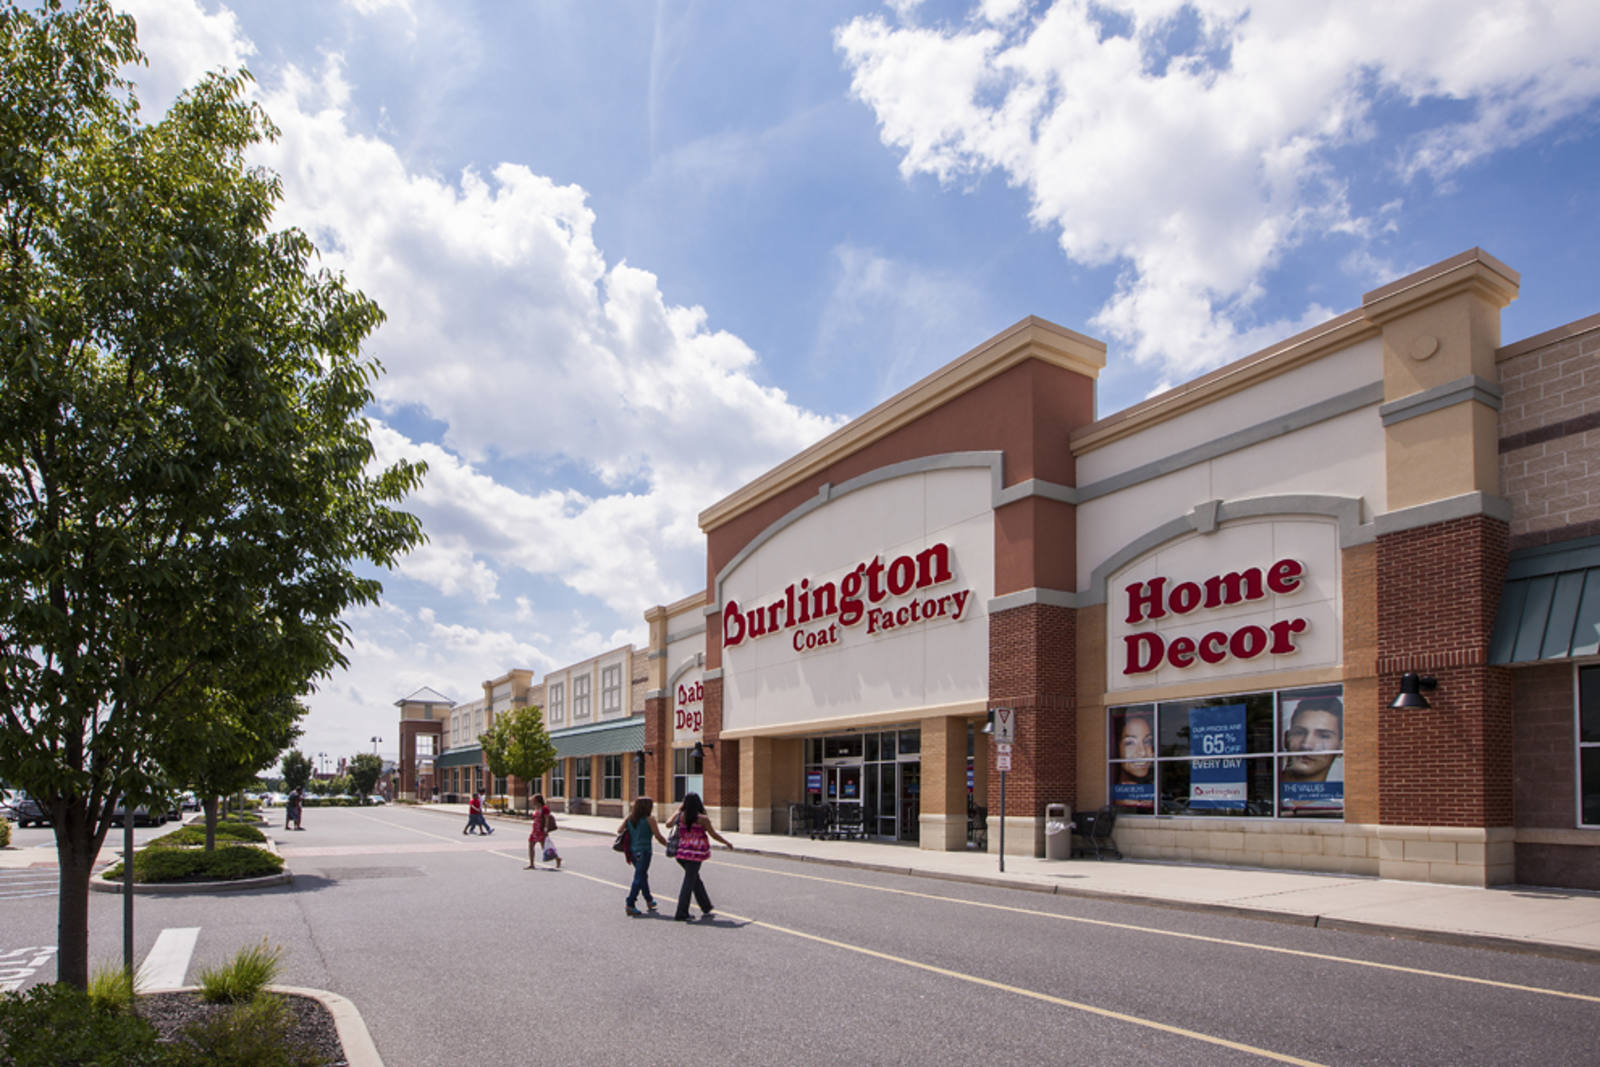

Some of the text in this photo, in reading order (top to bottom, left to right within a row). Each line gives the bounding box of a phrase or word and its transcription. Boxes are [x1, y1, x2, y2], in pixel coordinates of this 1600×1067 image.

[723, 543, 953, 649] Burlington
[792, 589, 970, 652] Coat Factory
[1125, 559, 1303, 624] Home
[1123, 618, 1307, 675] Decor
[1192, 758, 1242, 769] EVERY DAY
